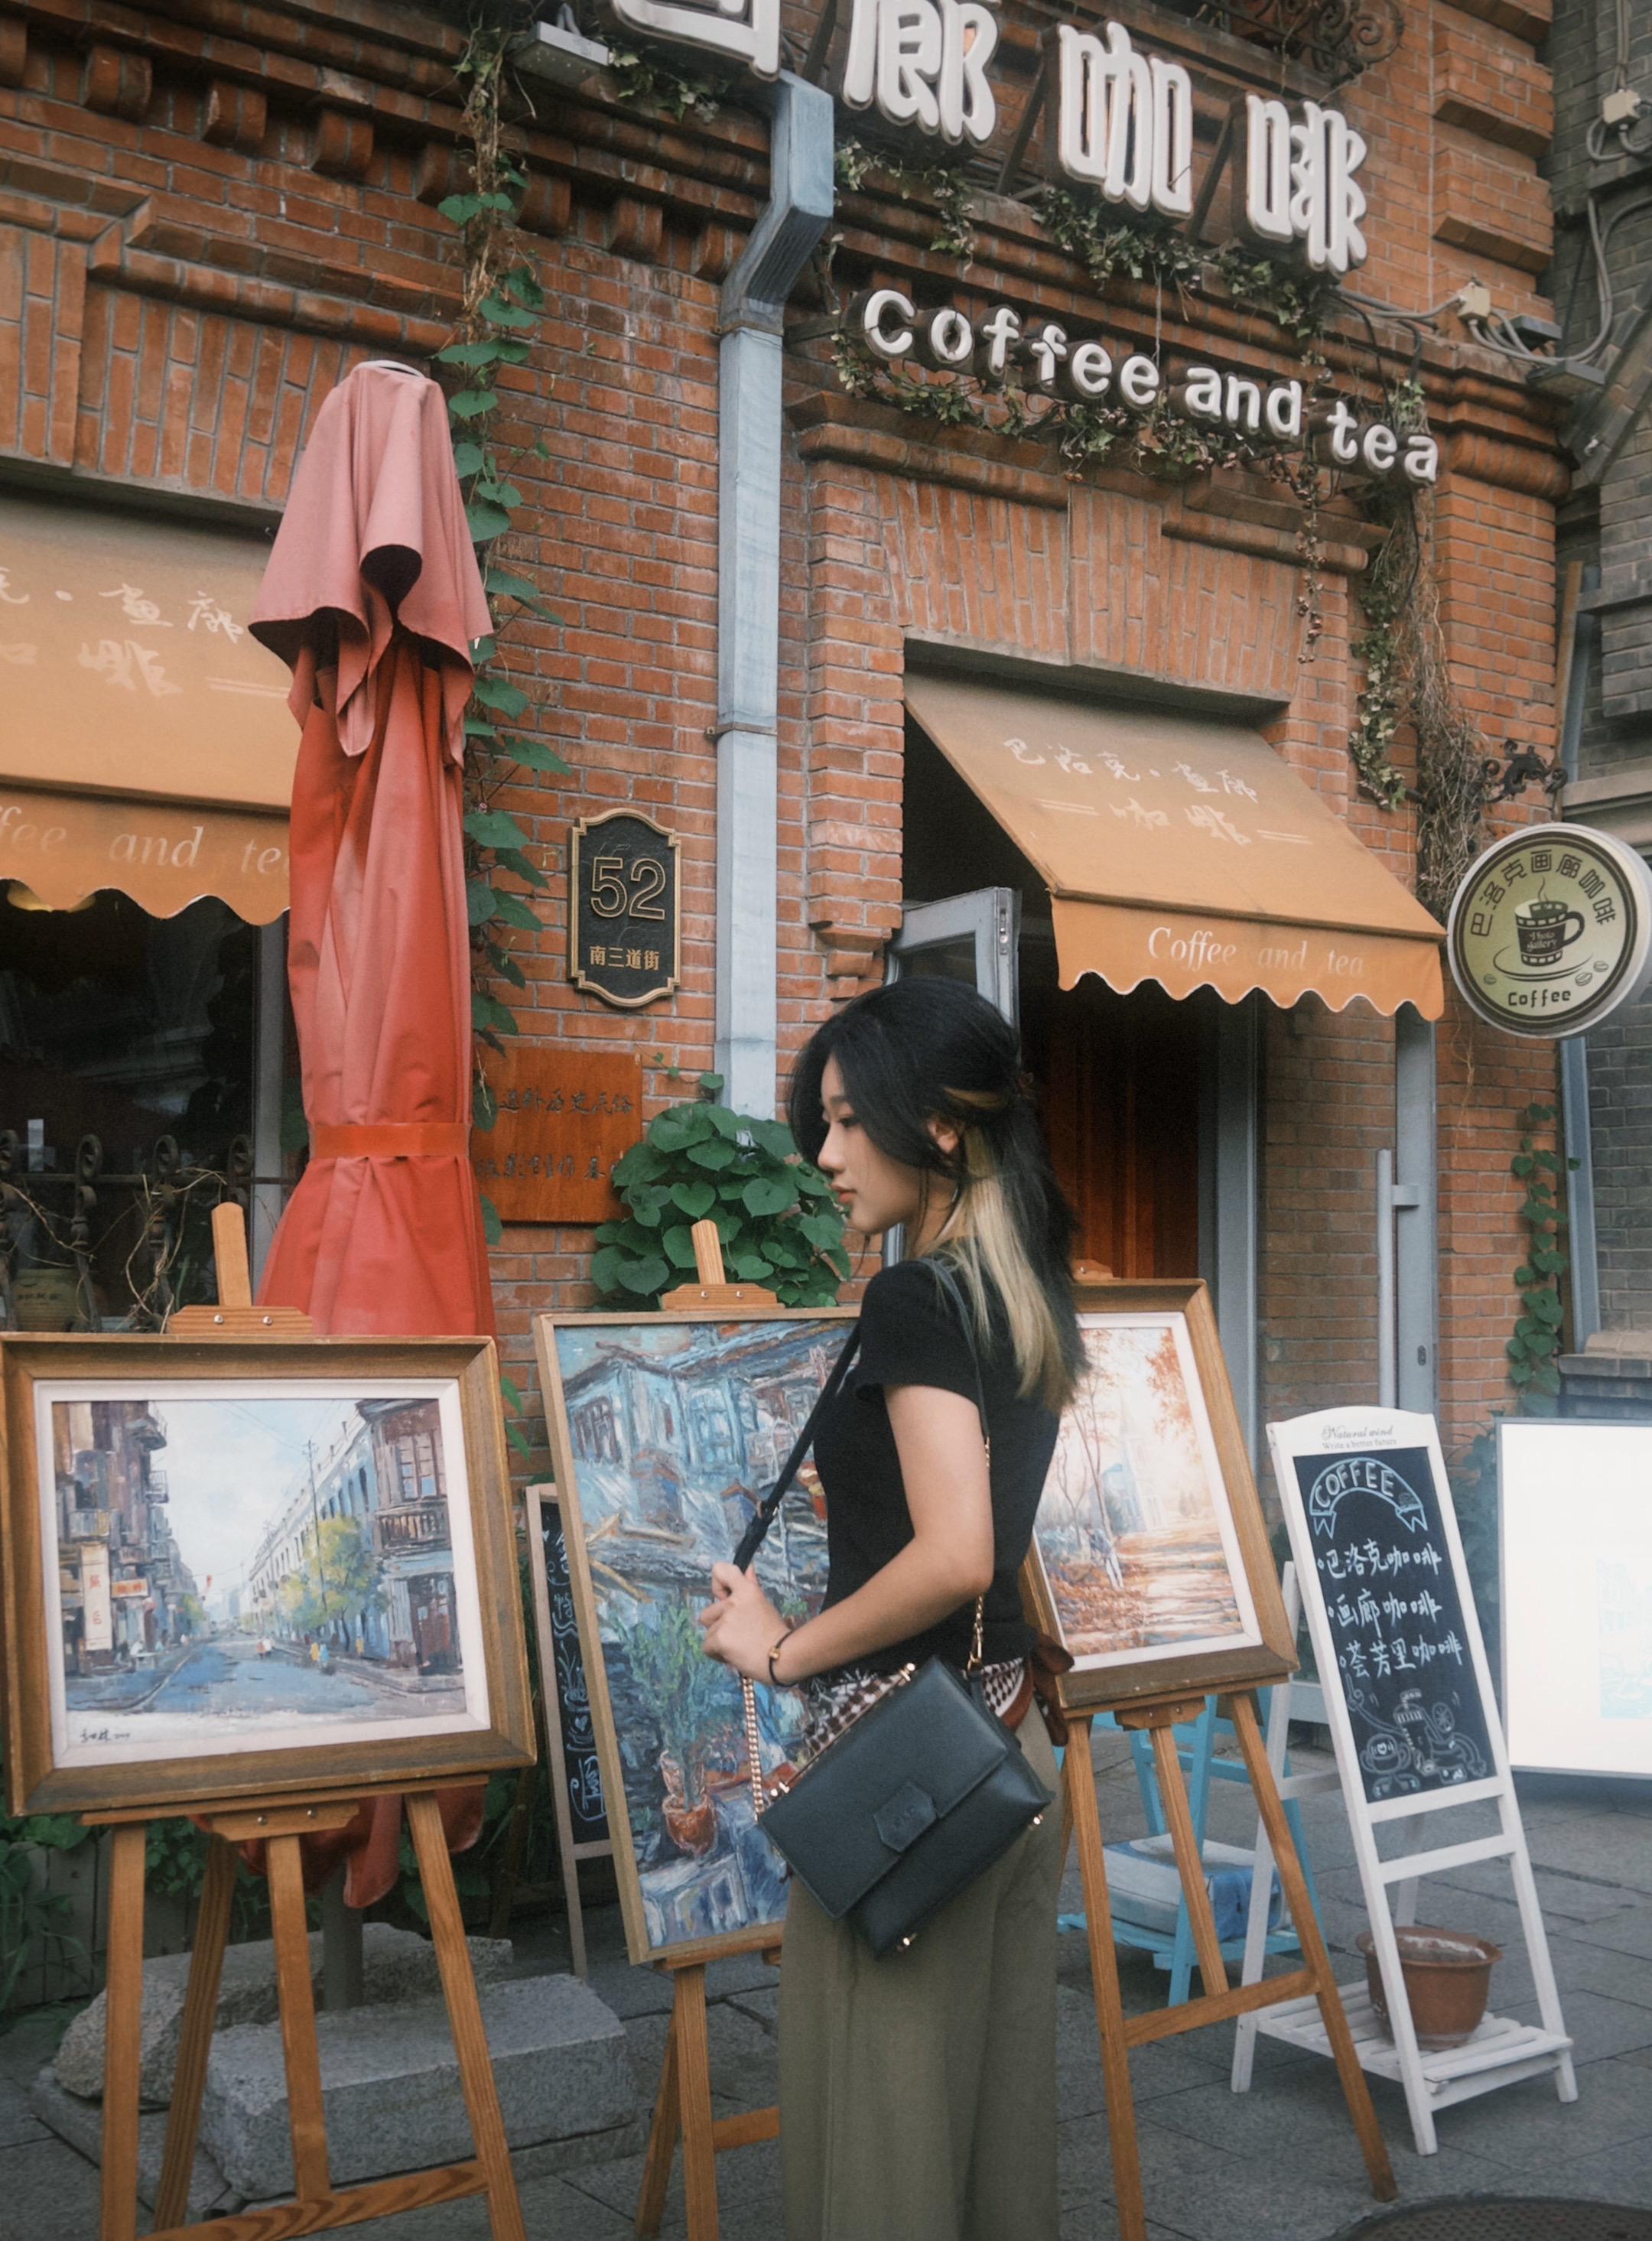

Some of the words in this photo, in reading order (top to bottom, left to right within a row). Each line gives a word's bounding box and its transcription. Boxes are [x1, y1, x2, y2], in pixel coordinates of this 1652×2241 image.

[864, 289, 1160, 405] Coffee
[1185, 367, 1302, 437] and
[1327, 401, 1439, 483] tea
[109, 825, 205, 868] and
[240, 838, 290, 877] te
[590, 857, 666, 920] 52
[1470, 849, 1616, 937] 巴洛克画廊咖啡
[590, 945, 661, 971] 南三道街
[1148, 926, 1237, 972] Coffee
[1258, 940, 1308, 971] and
[1327, 948, 1364, 977] tea
[1507, 988, 1572, 1009] Coffee
[1314, 1460, 1394, 1508] COFFEE
[1325, 1537, 1442, 1579] 巴洛克咖啡
[1336, 1587, 1442, 1639] 画廊咖啡
